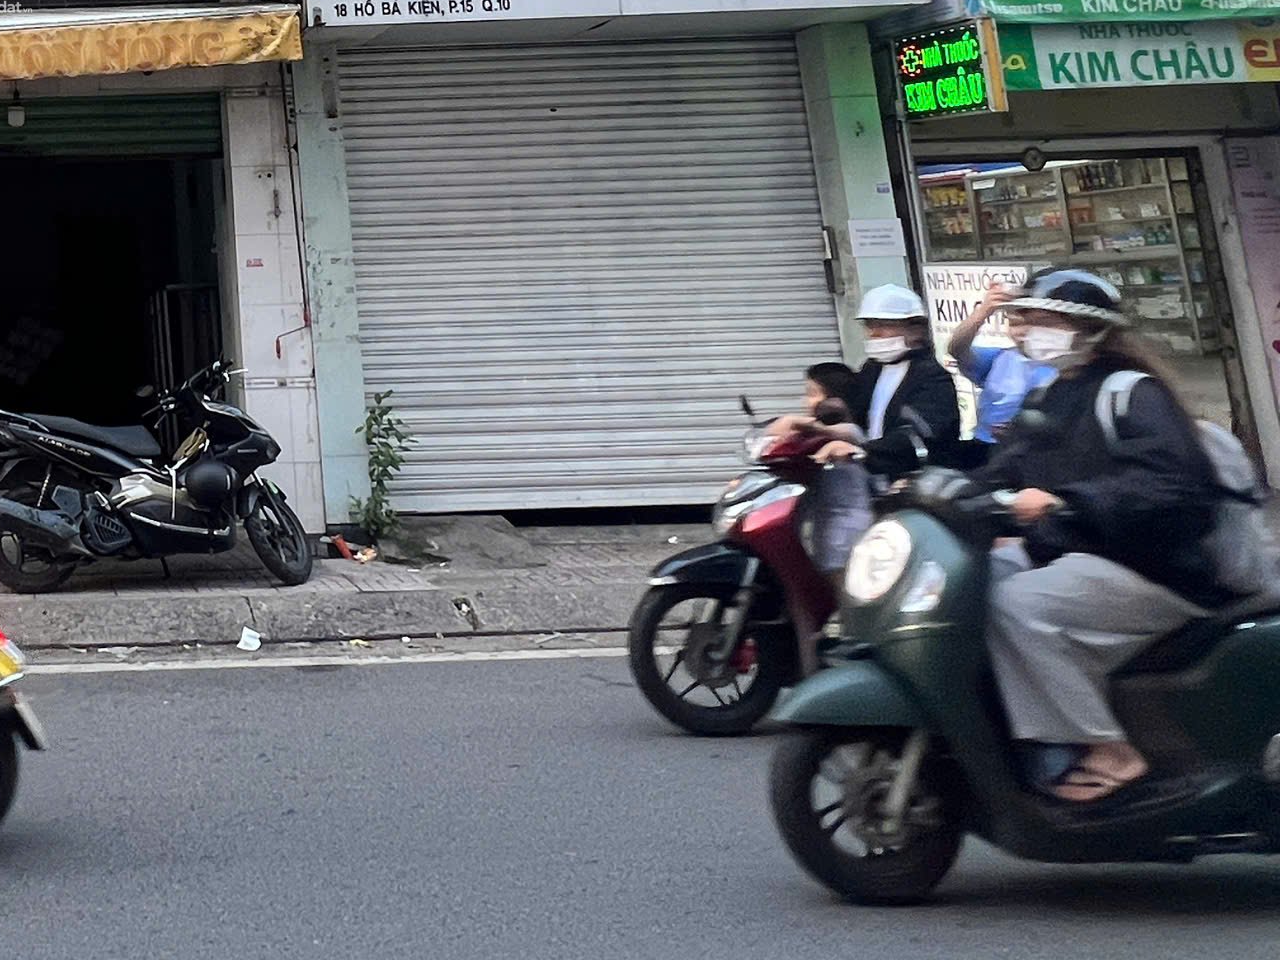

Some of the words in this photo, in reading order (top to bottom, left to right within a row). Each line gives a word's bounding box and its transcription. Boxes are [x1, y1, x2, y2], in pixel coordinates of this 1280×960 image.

[334, 3, 347, 17] 18
[921, 41, 943, 69] NHÀ
[1049, 50, 1121, 84] KIM
[1130, 40, 1235, 81] CHÂU
[904, 81, 936, 112] KIM
[936, 66, 983, 109] CHÂU
[927, 269, 955, 290] NHÀ
[935, 299, 969, 322] KIM
